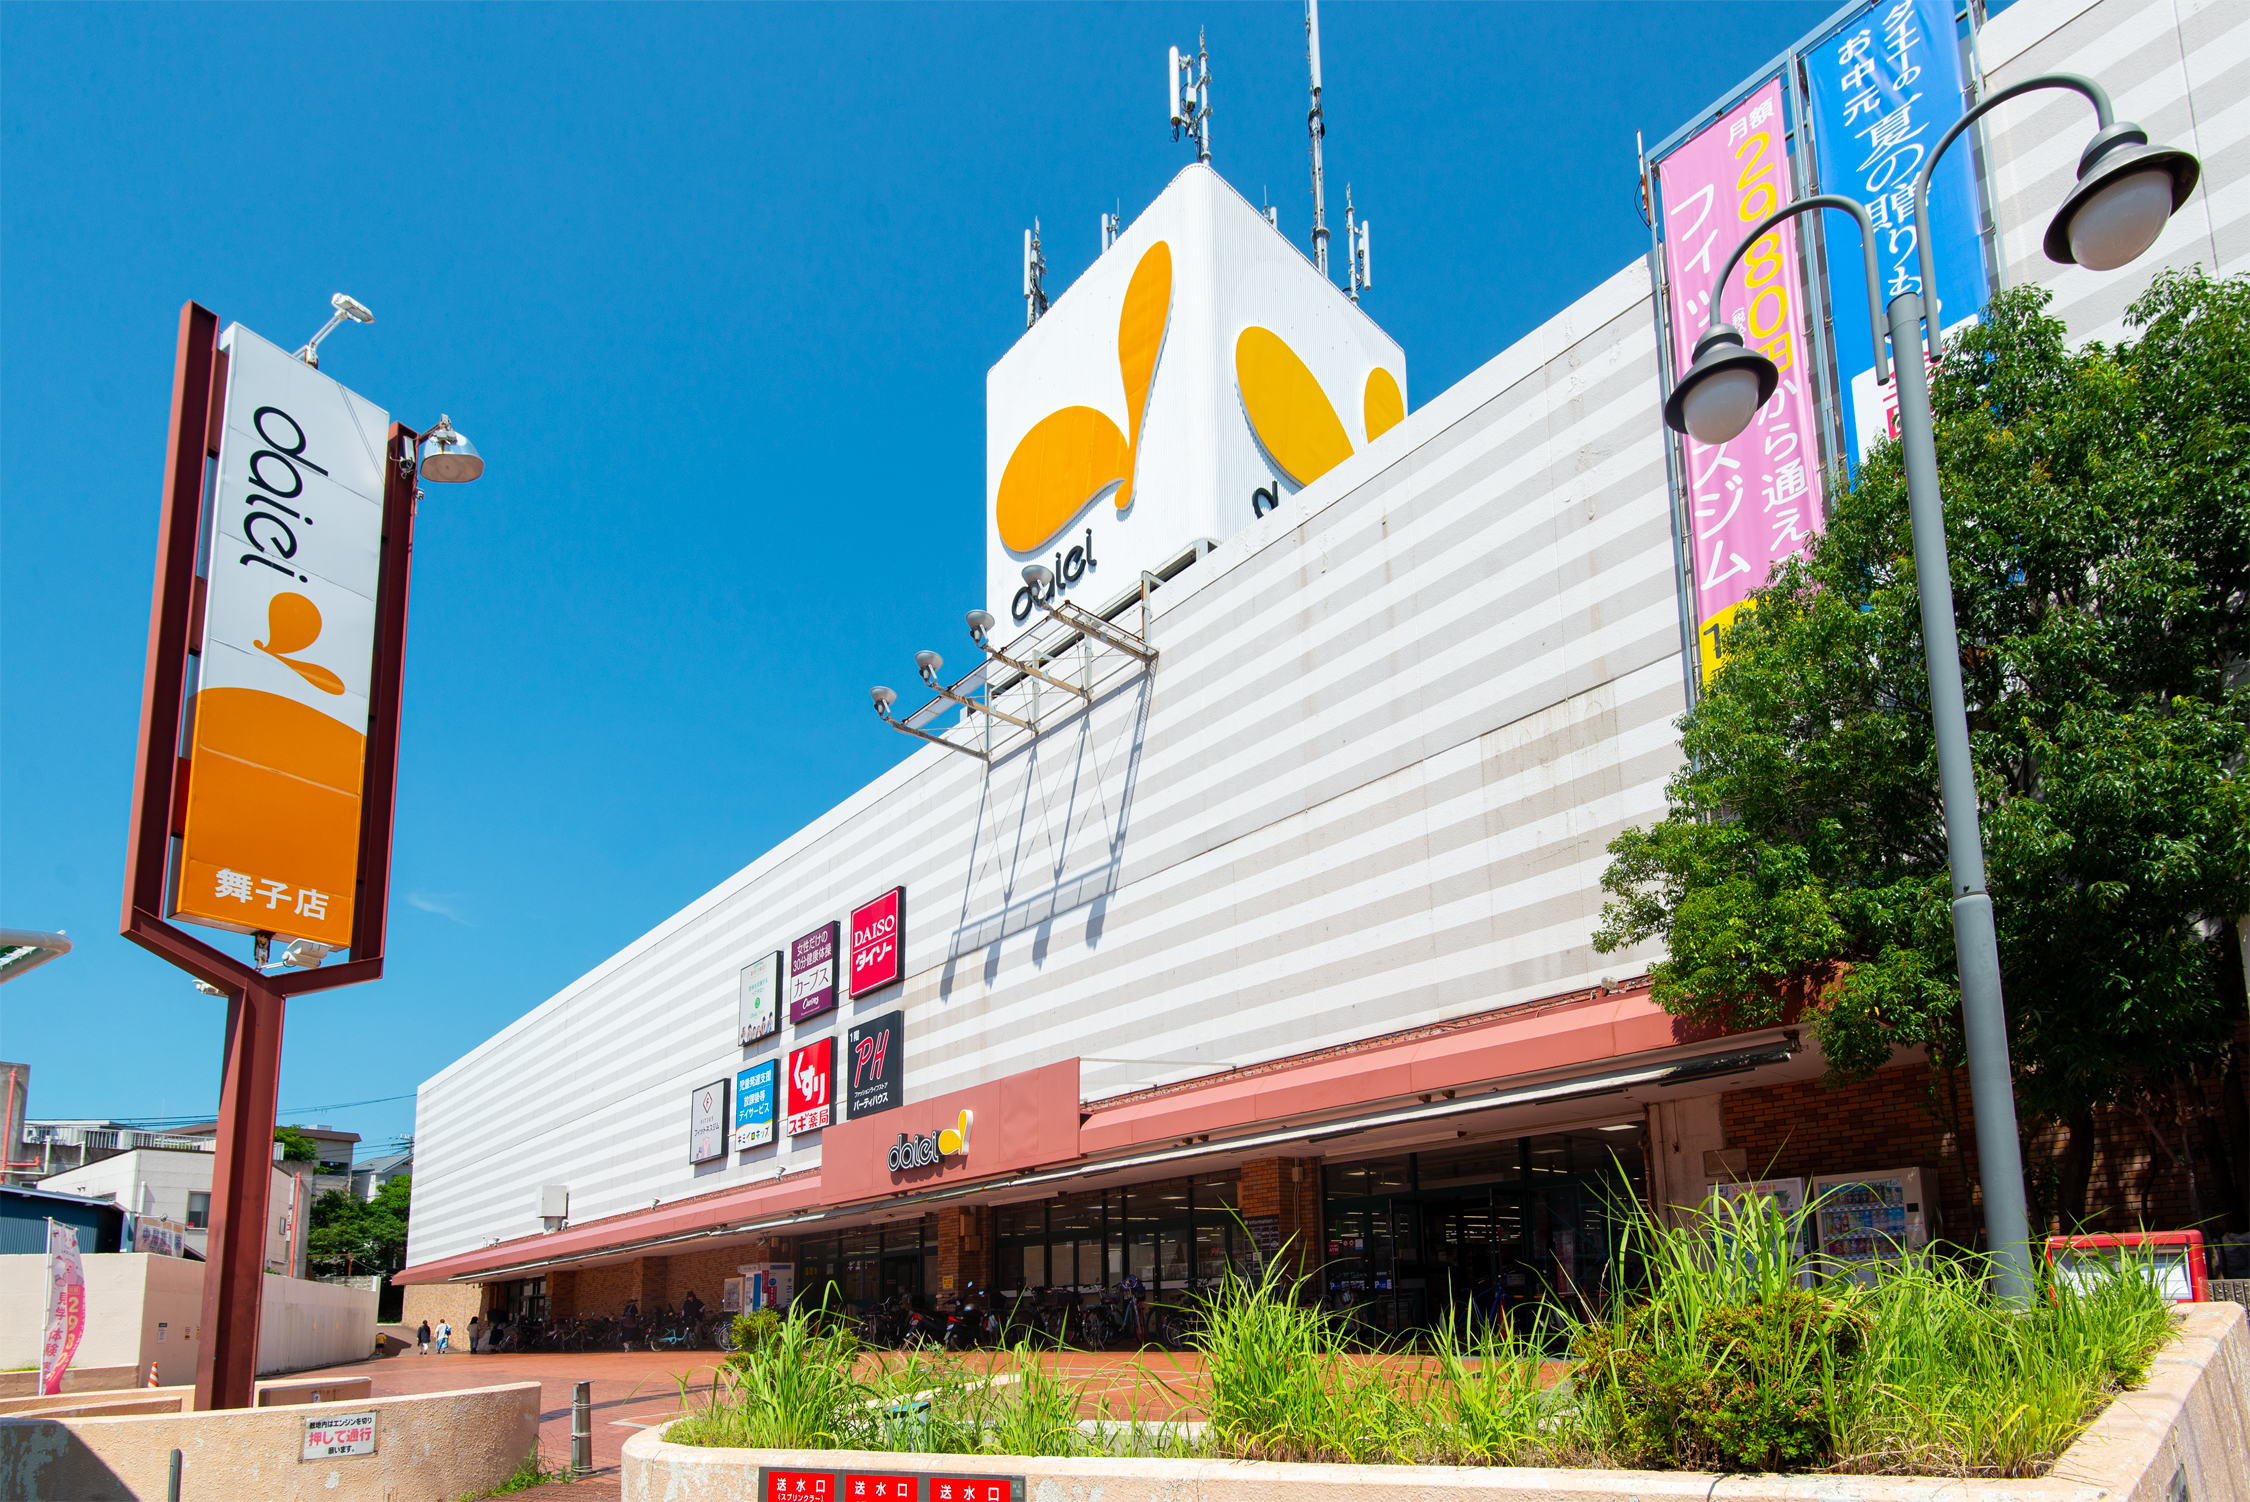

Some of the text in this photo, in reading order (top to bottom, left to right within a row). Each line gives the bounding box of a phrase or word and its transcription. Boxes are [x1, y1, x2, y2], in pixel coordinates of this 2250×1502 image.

[1838, 29, 1881, 127] お中元
[1727, 97, 1775, 148] 月額
[1670, 183, 1751, 591] フィッスジム
[239, 405, 329, 583] daiei
[214, 866, 329, 922] 舞子店
[796, 930, 829, 957] 女性だけの
[853, 914, 895, 948] DAISO
[792, 942, 832, 972] 30分健康体操
[855, 941, 893, 972] ダイソー
[793, 967, 829, 998] カーブス
[849, 1030, 860, 1043] 1階
[854, 1028, 889, 1088] PH
[793, 1050, 826, 1105] くすり
[739, 1102, 770, 1122] デイサービス
[788, 1108, 829, 1135] スギ薬局
[887, 1129, 942, 1173] daiei
[308, 1427, 372, 1447] 押して通行
[327, 1445, 355, 1455] 願います。
[776, 1477, 827, 1493] 送水口
[855, 1480, 908, 1498] 送水口
[940, 1484, 1000, 1502] 送水口
